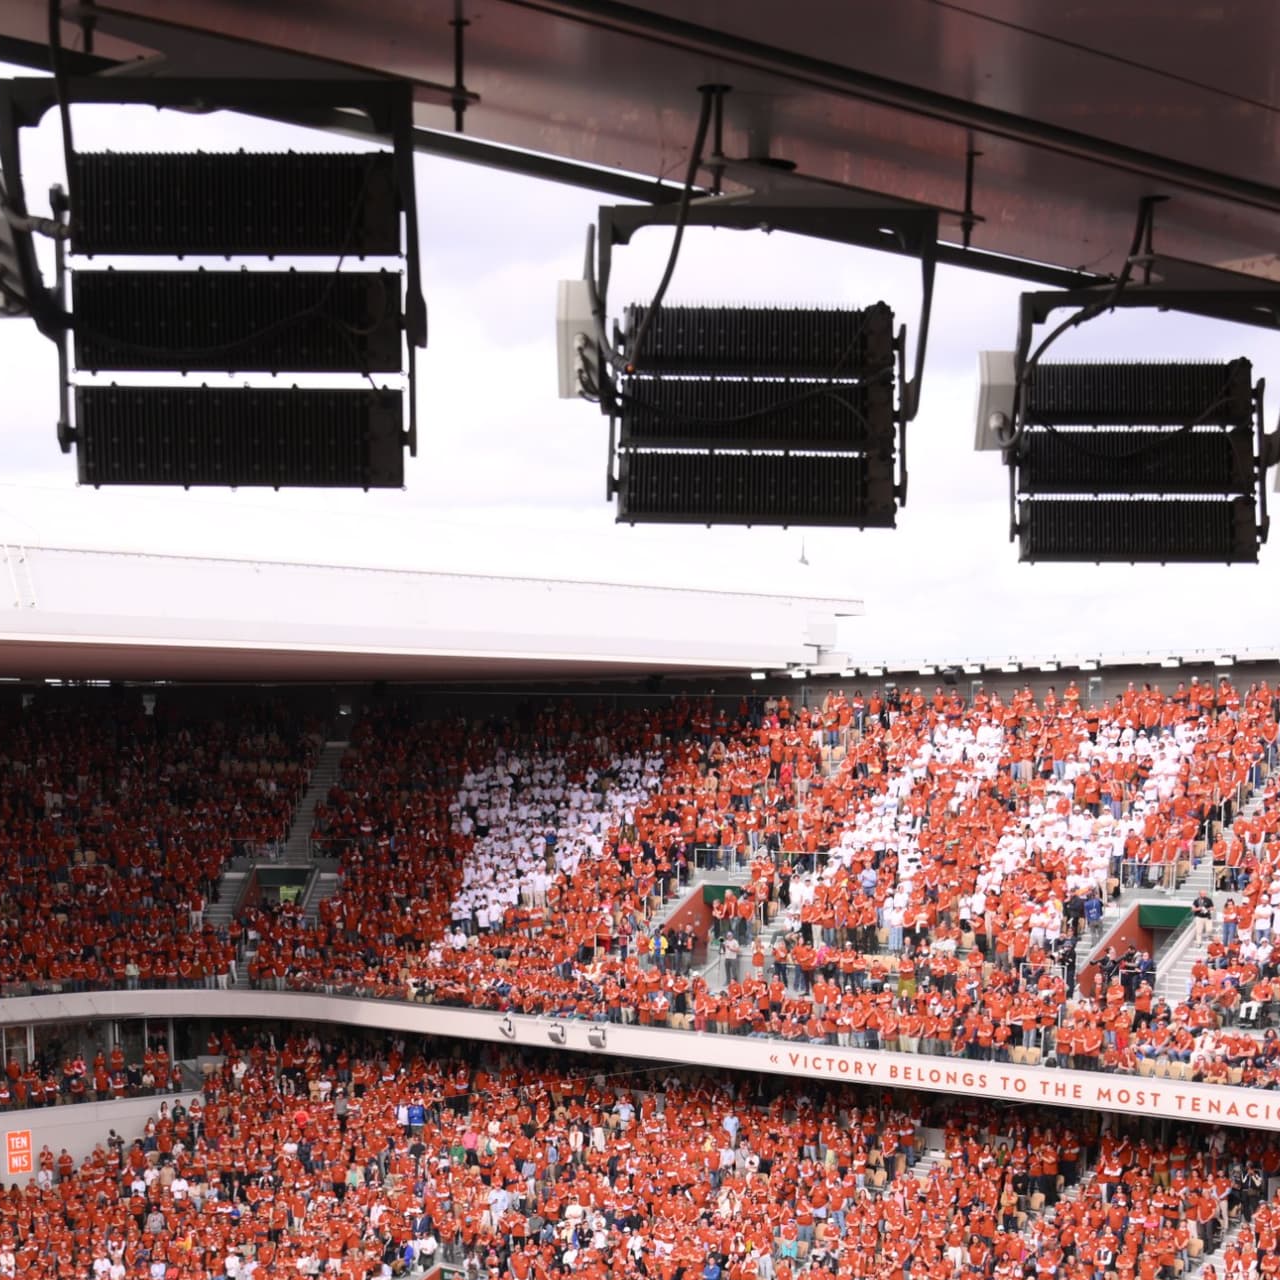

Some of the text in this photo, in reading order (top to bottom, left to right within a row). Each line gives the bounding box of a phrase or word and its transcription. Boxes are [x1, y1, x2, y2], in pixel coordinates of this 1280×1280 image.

[788, 1052, 877, 1077] VICTORY
[889, 1064, 988, 1088] BELONGS
[1000, 1076, 1028, 1092] TO
[1039, 1081, 1083, 1099] THE
[1097, 1088, 1161, 1107] MOST
[10, 1137, 28, 1149] TEN
[11, 1155, 29, 1168] NIS
